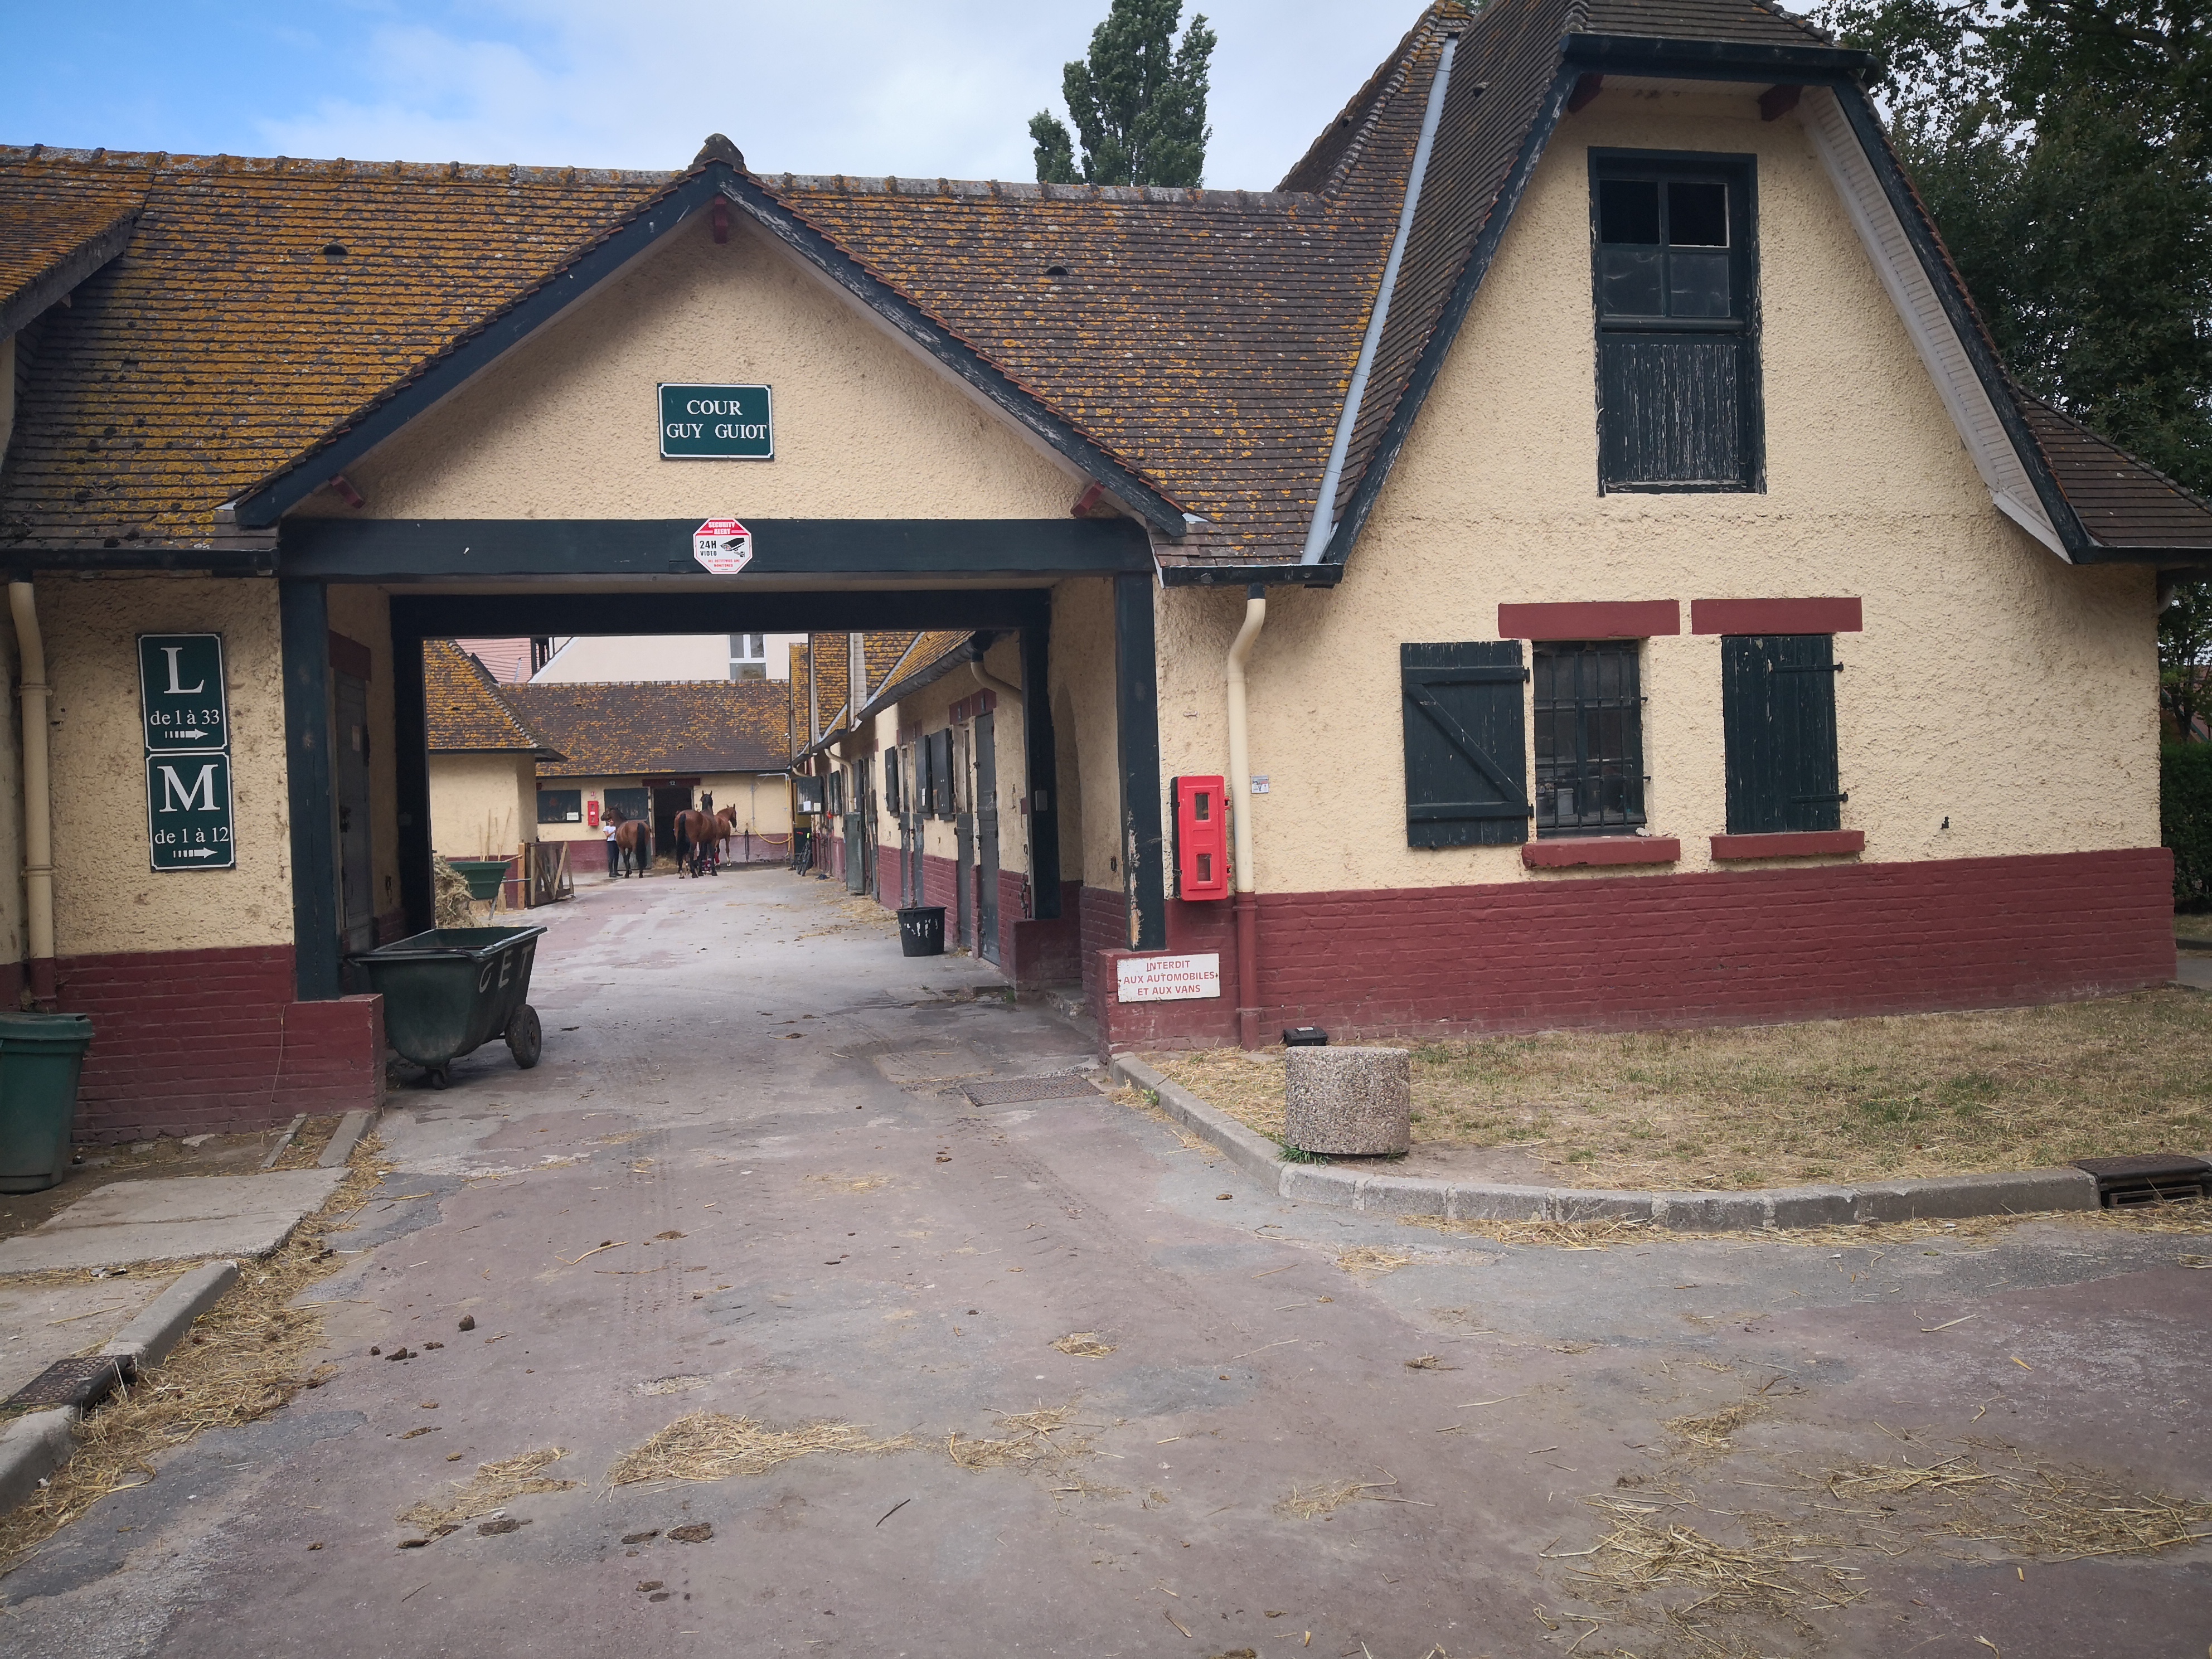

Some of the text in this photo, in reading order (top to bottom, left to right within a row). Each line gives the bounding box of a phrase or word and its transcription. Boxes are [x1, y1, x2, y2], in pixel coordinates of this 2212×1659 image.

[686, 400, 743, 415] COUR
[666, 423, 767, 439] GUY GUIOT
[700, 540, 717, 549] 24H
[160, 647, 204, 693] L
[150, 709, 220, 725] de 1 à 33
[157, 764, 220, 812] M
[154, 827, 229, 845] de 1 à 12
[1146, 960, 1190, 972] INTERDIT
[1123, 971, 1215, 984] AUX AUTOMOBILES
[1137, 984, 1201, 996] ET AUX VANS
